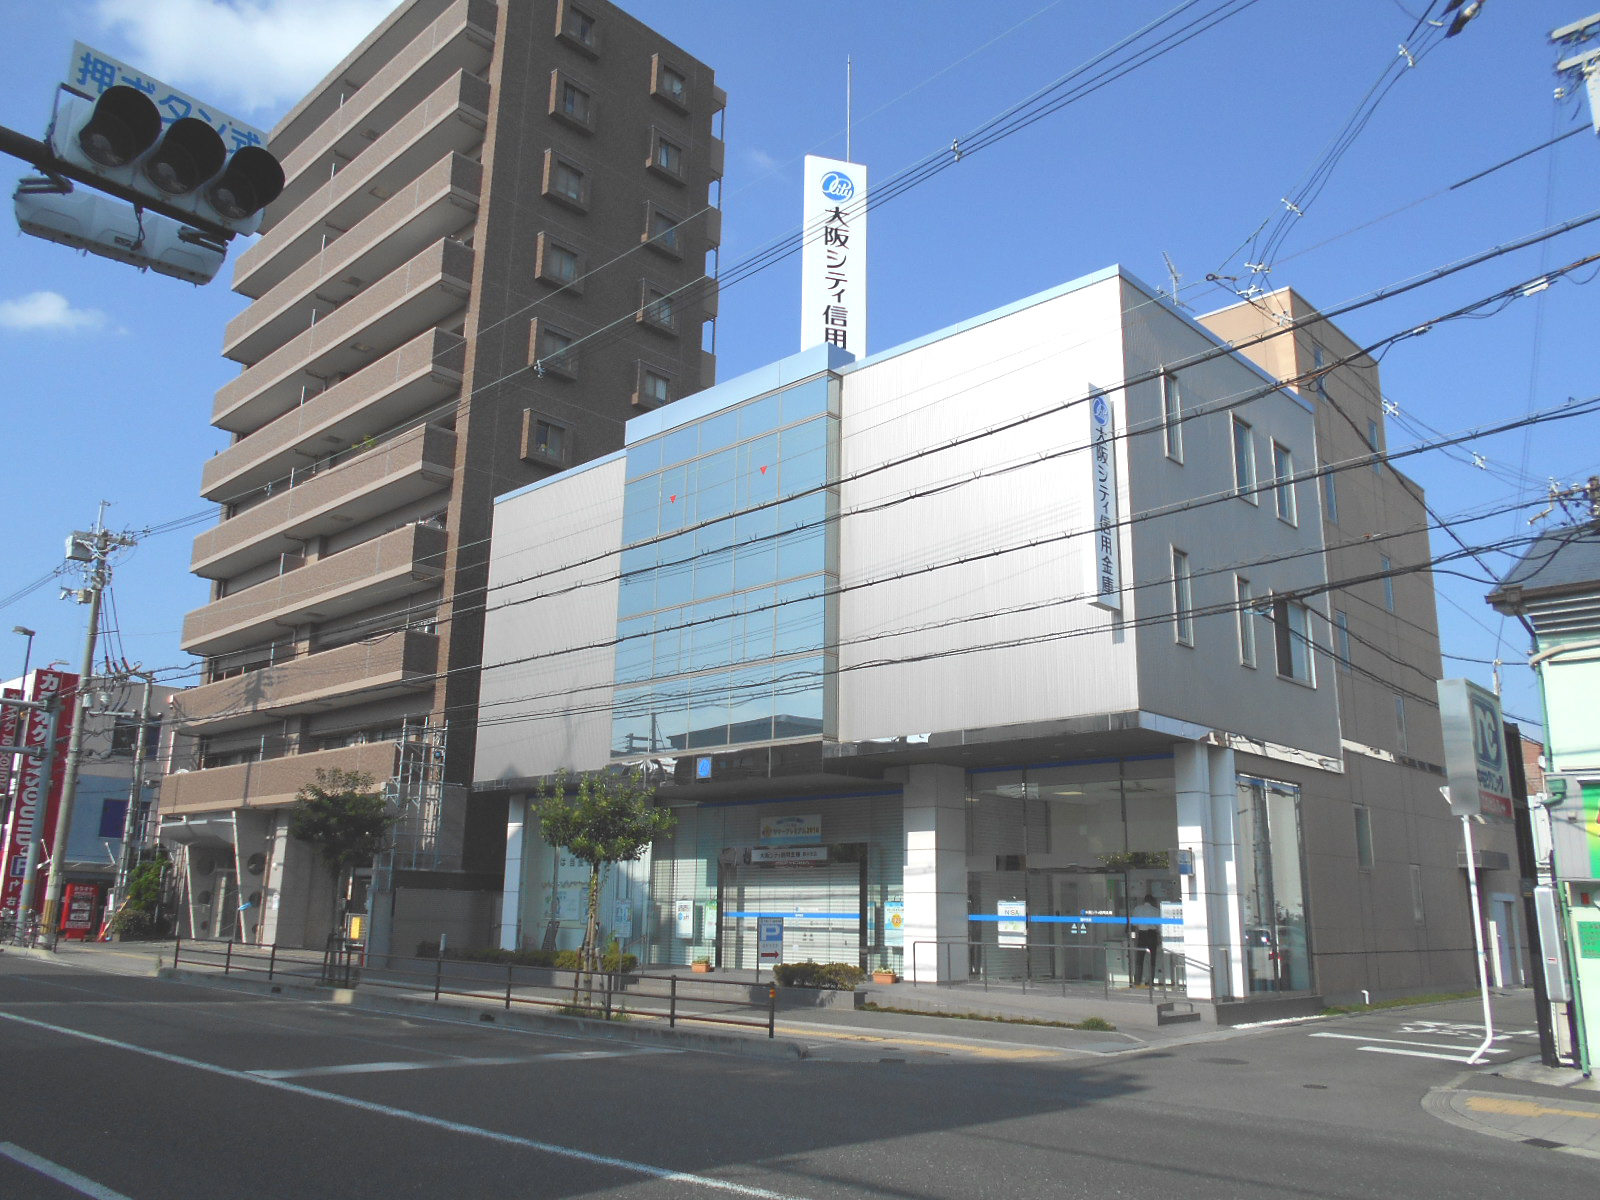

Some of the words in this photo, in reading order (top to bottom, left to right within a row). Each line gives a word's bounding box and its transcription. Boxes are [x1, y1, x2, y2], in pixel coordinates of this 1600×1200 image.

[1096, 426, 1114, 595] 大阪シティ信用金庫
[761, 925, 781, 941] P
